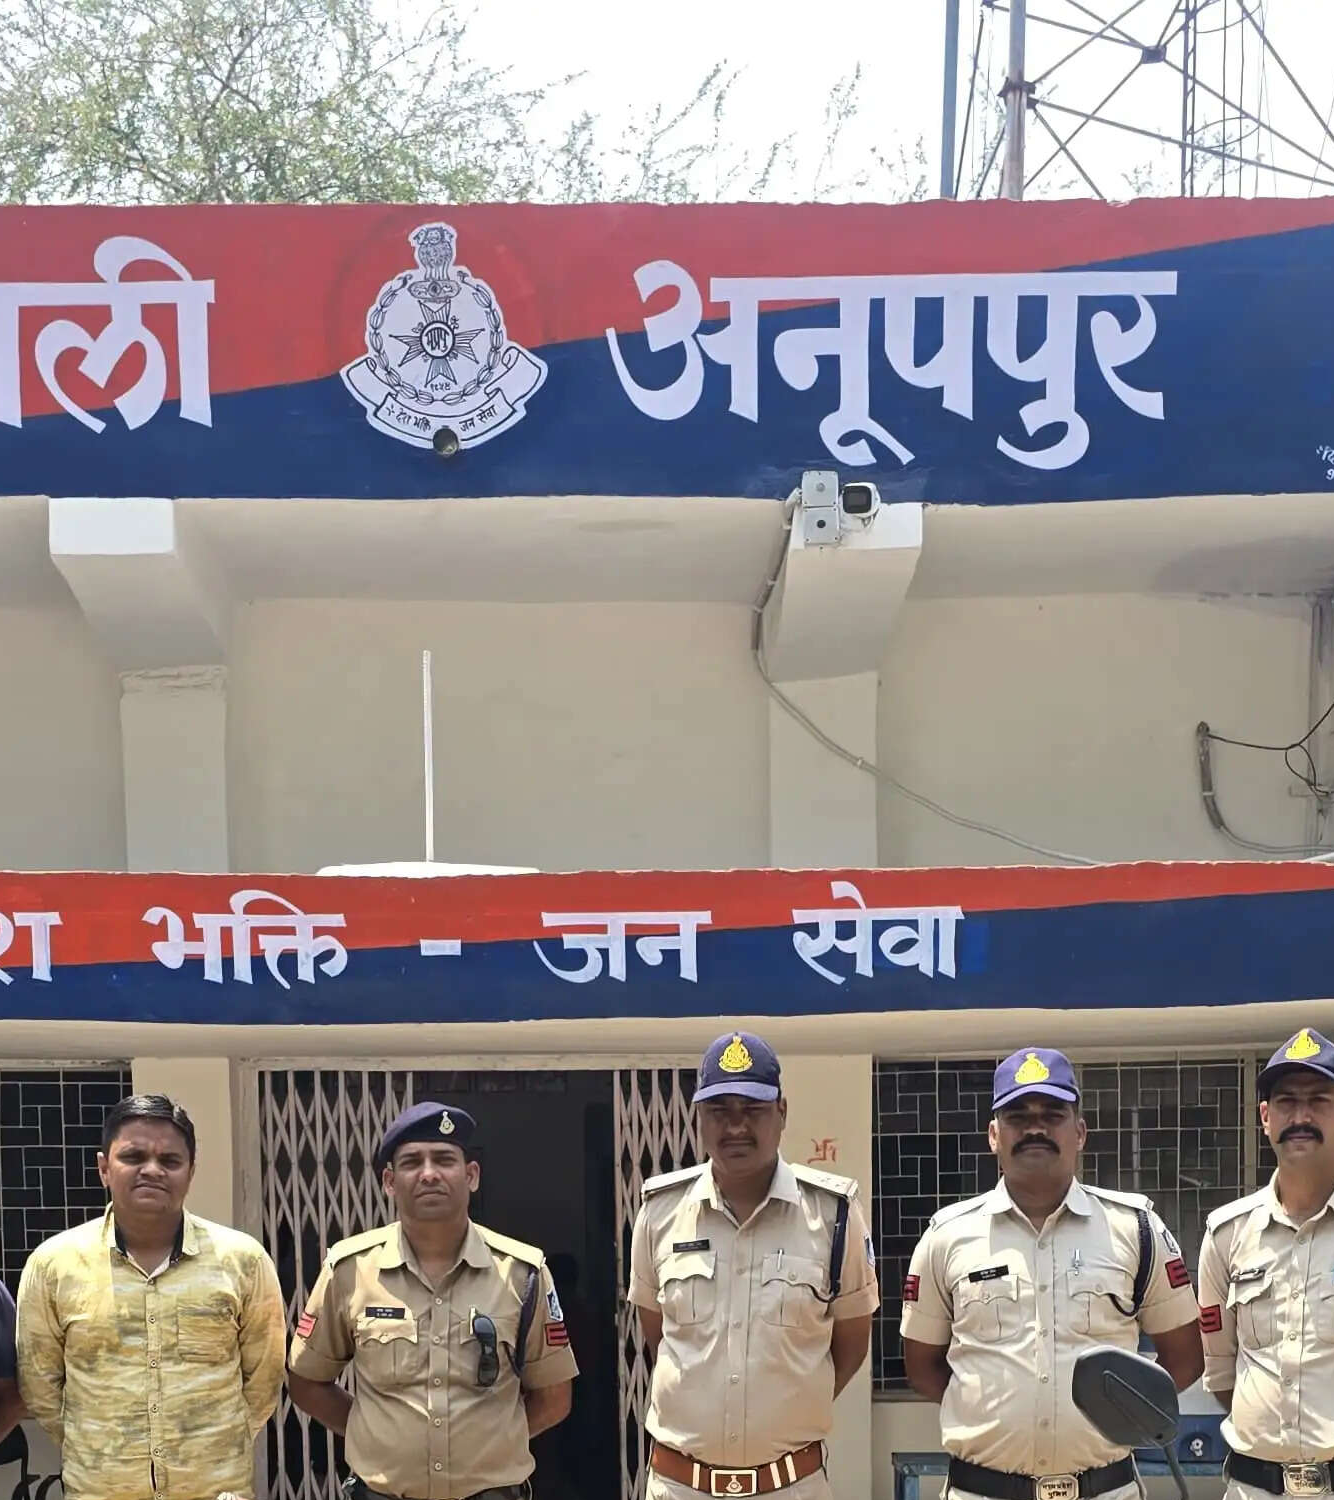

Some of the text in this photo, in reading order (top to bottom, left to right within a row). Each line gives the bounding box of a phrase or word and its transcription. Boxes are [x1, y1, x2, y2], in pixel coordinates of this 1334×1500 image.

[605, 260, 1178, 470] अनूपपुर
[142, 889, 348, 989] भक्ति
[533, 910, 712, 983] जन
[792, 881, 965, 984] सेवा
